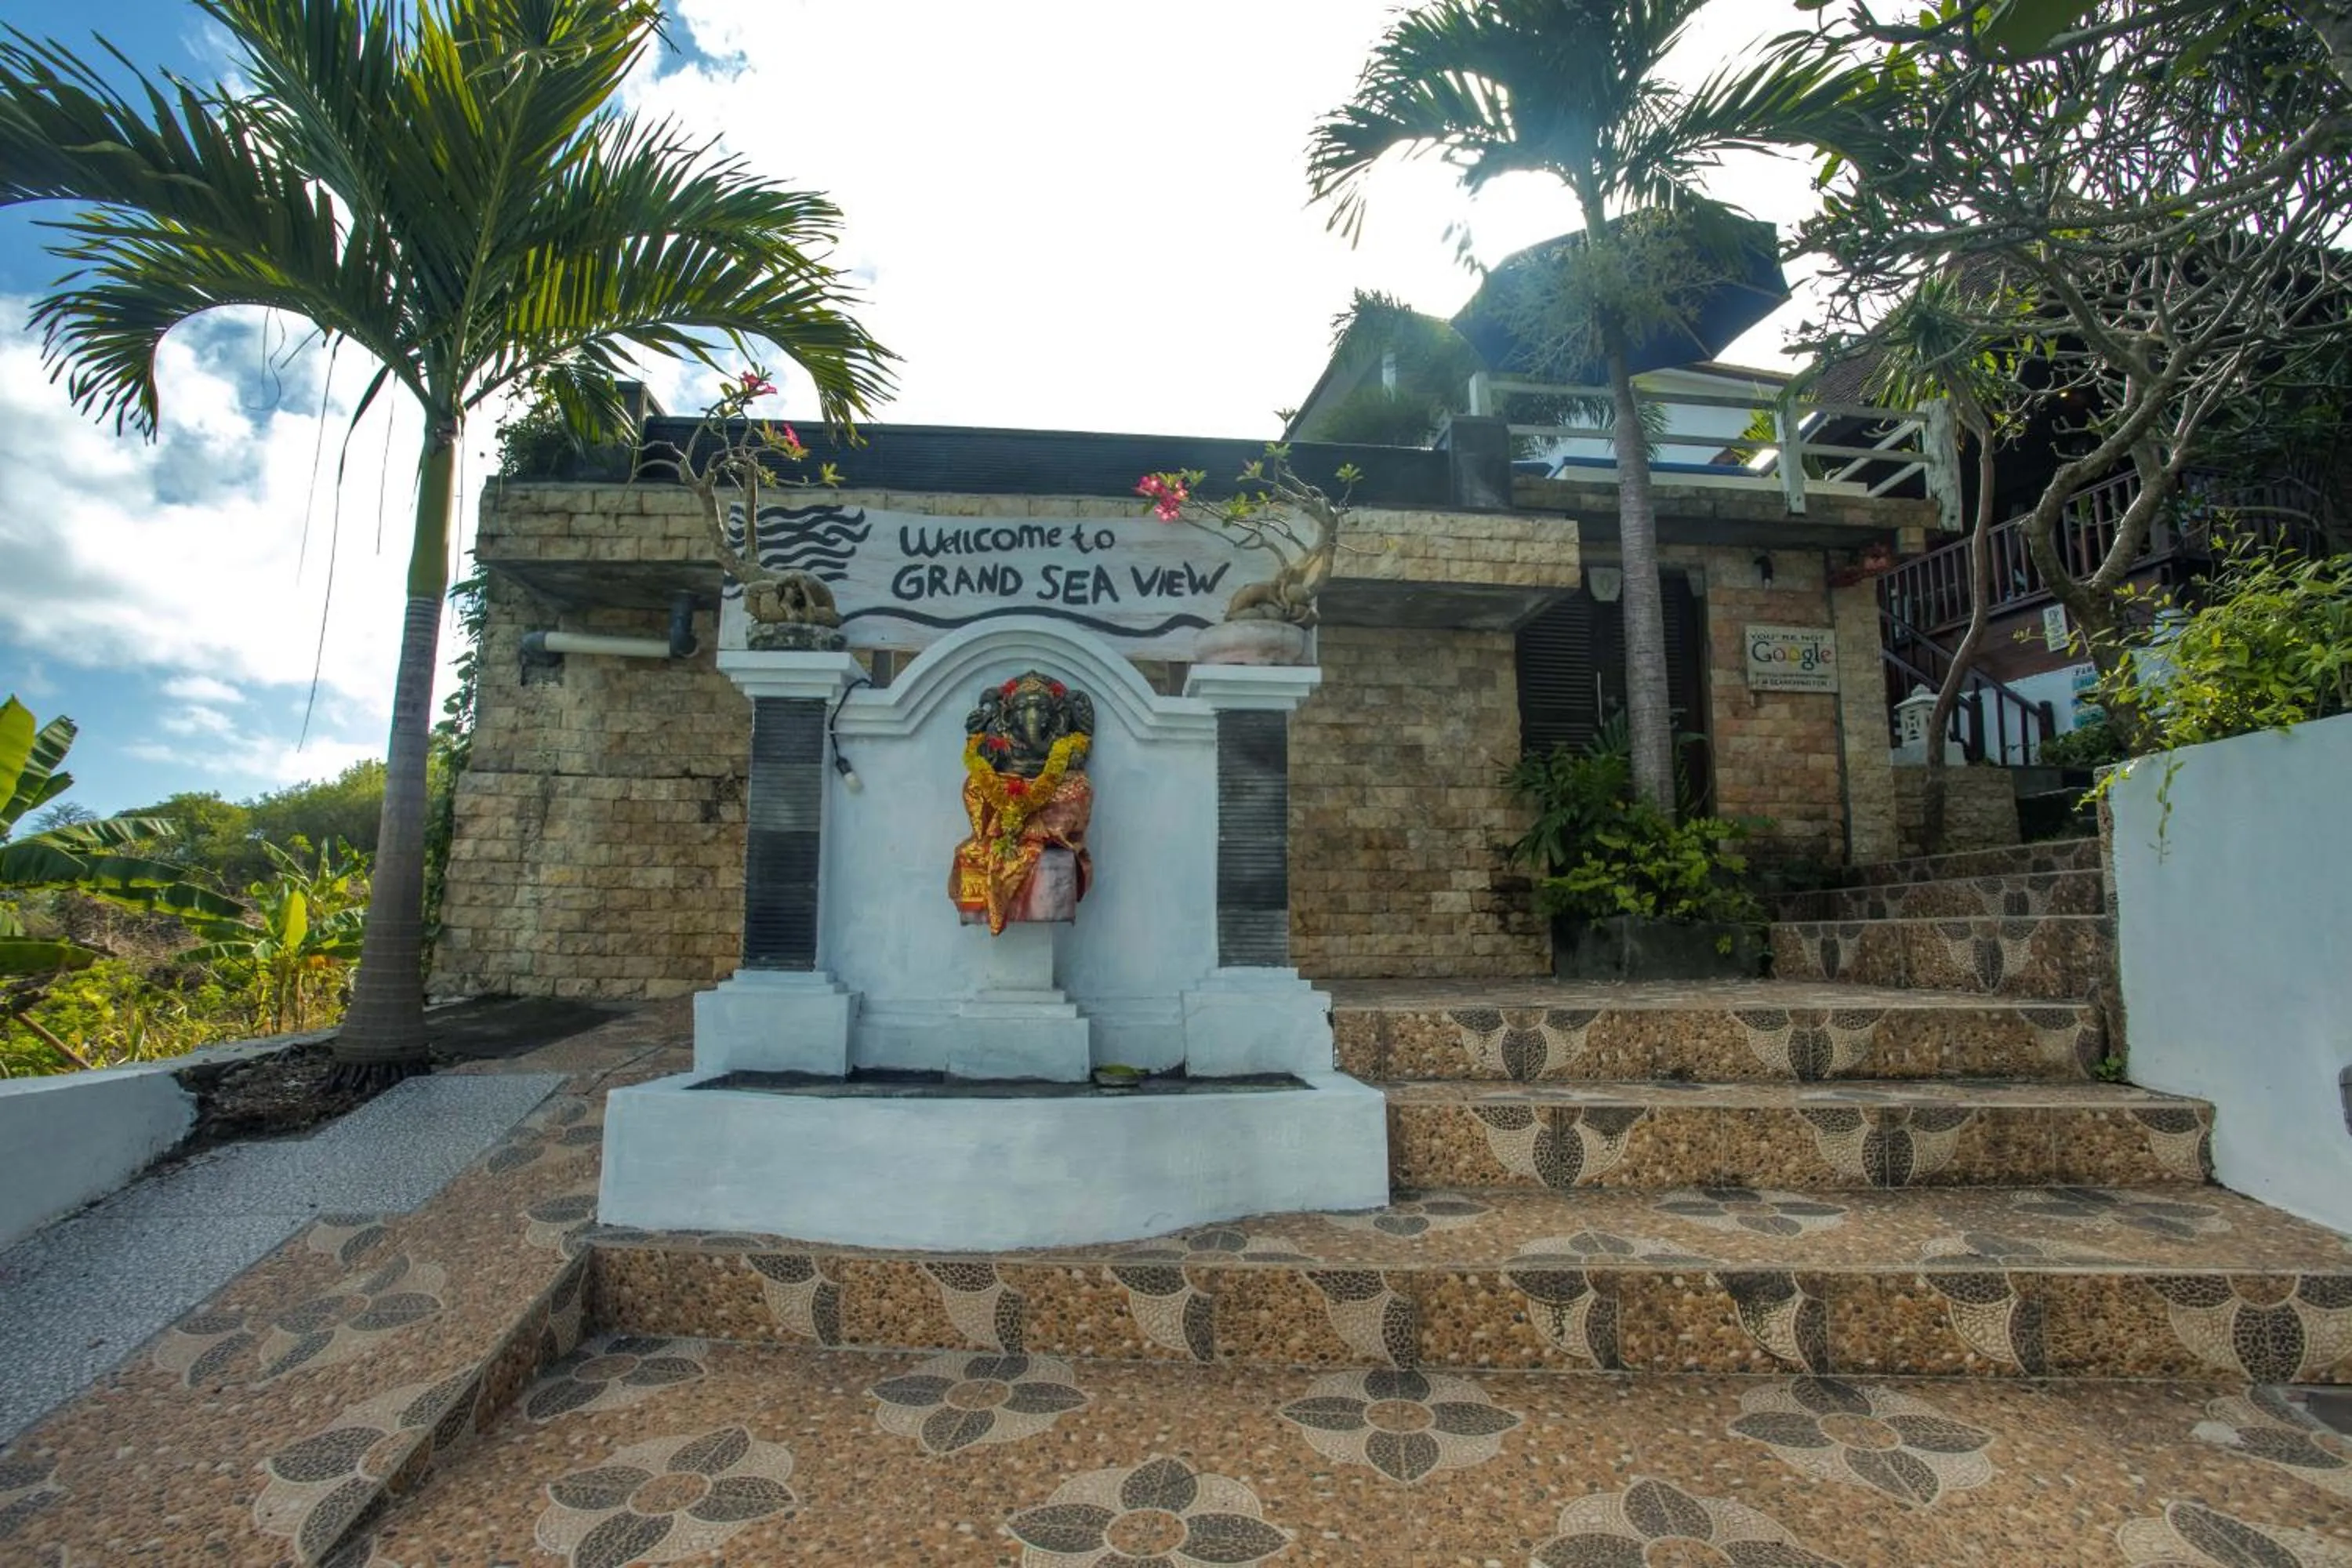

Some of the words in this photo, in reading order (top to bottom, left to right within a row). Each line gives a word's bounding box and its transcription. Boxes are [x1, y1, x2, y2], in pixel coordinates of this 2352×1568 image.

[900, 524, 1061, 557] Wellcome
[1071, 524, 1116, 554] to
[891, 564, 1023, 601] GRAND
[1036, 564, 1120, 605] SEA
[1130, 561, 1232, 598] VIEW
[1751, 641, 1831, 670] Google
